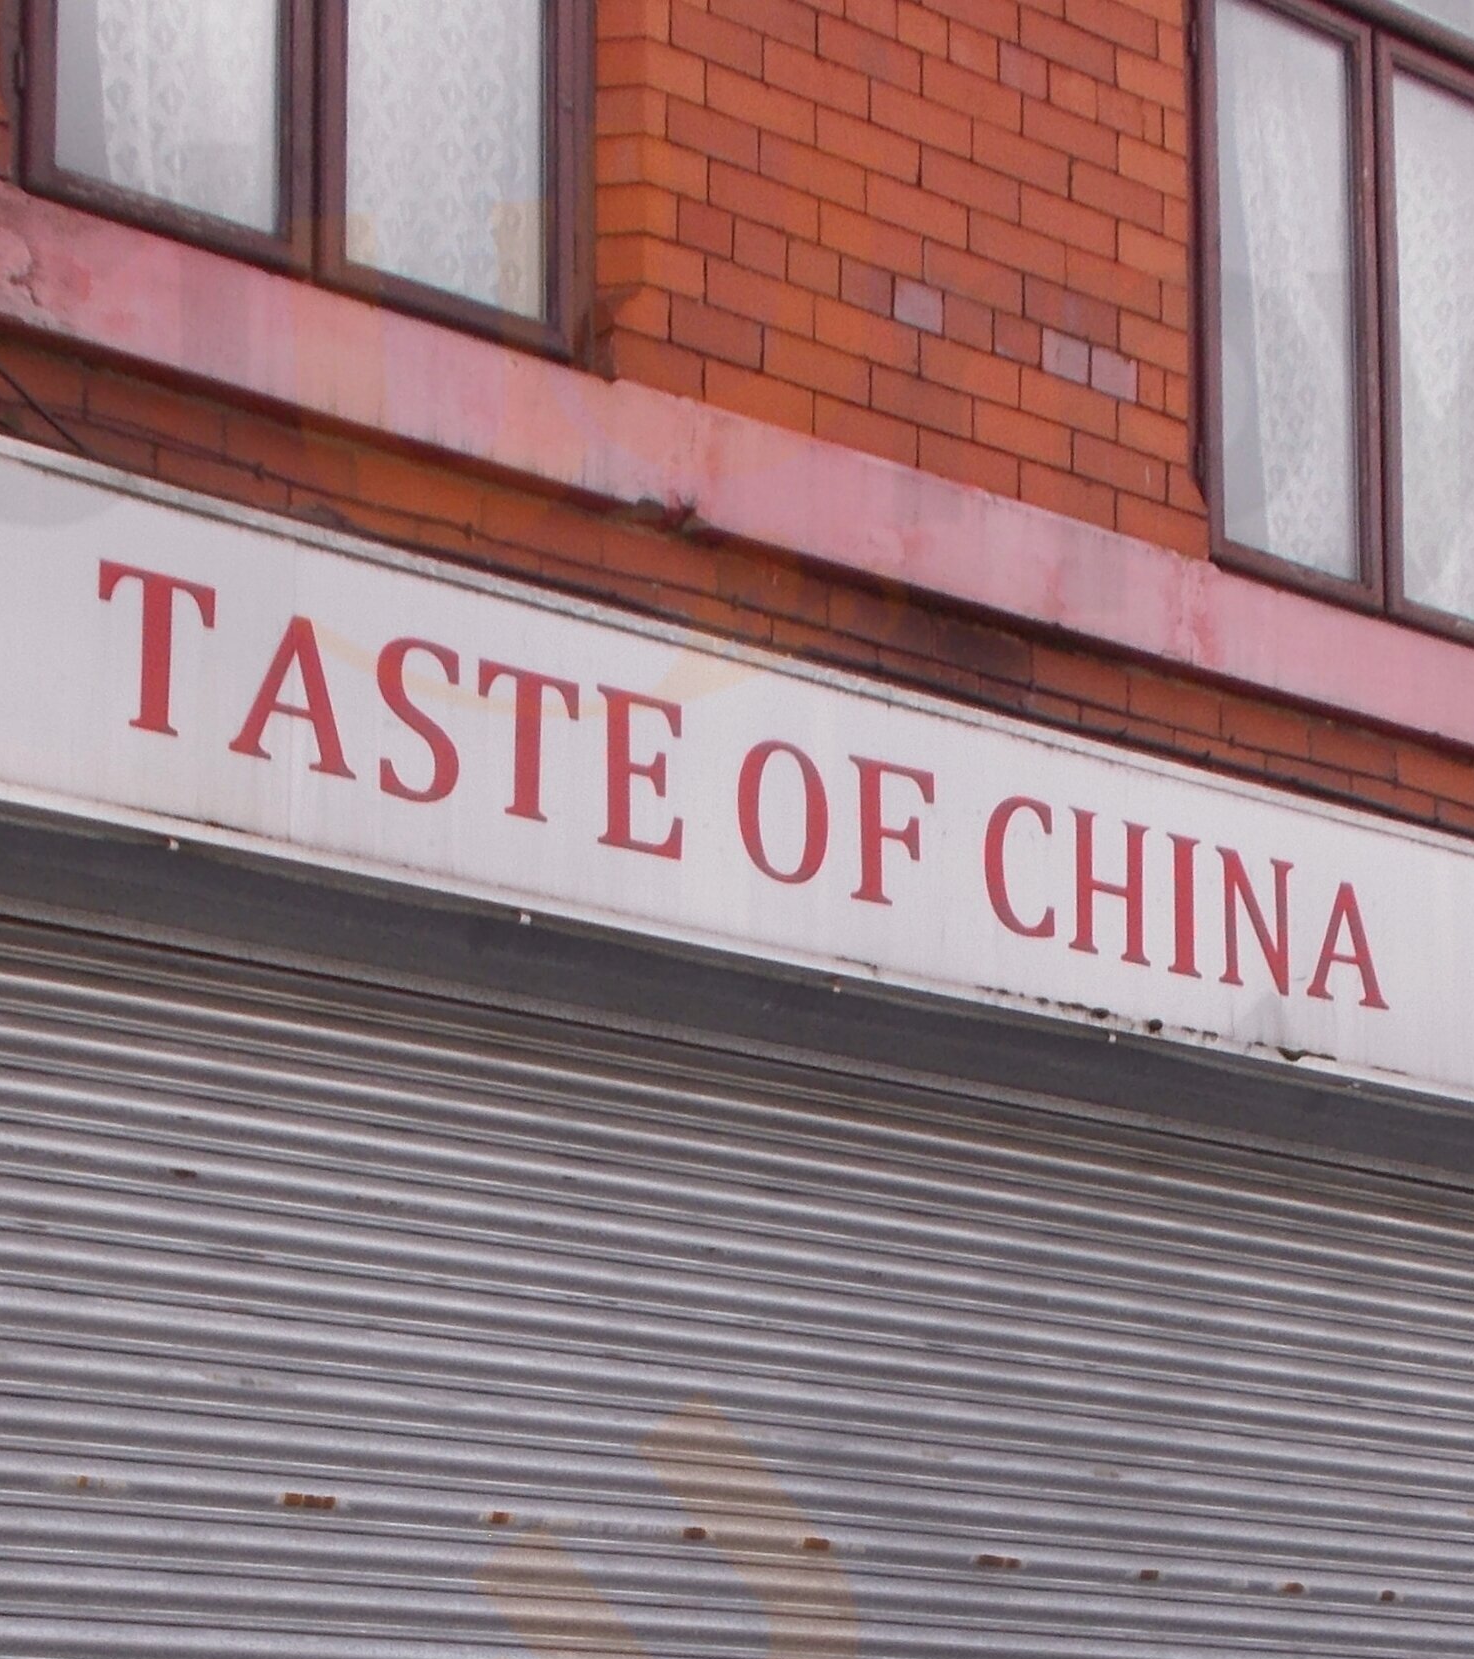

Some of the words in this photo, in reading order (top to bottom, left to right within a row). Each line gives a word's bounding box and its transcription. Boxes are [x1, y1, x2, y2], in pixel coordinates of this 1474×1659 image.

[98, 558, 683, 860] TASTE
[736, 740, 935, 906] OF
[984, 796, 1390, 1010] CHINA
